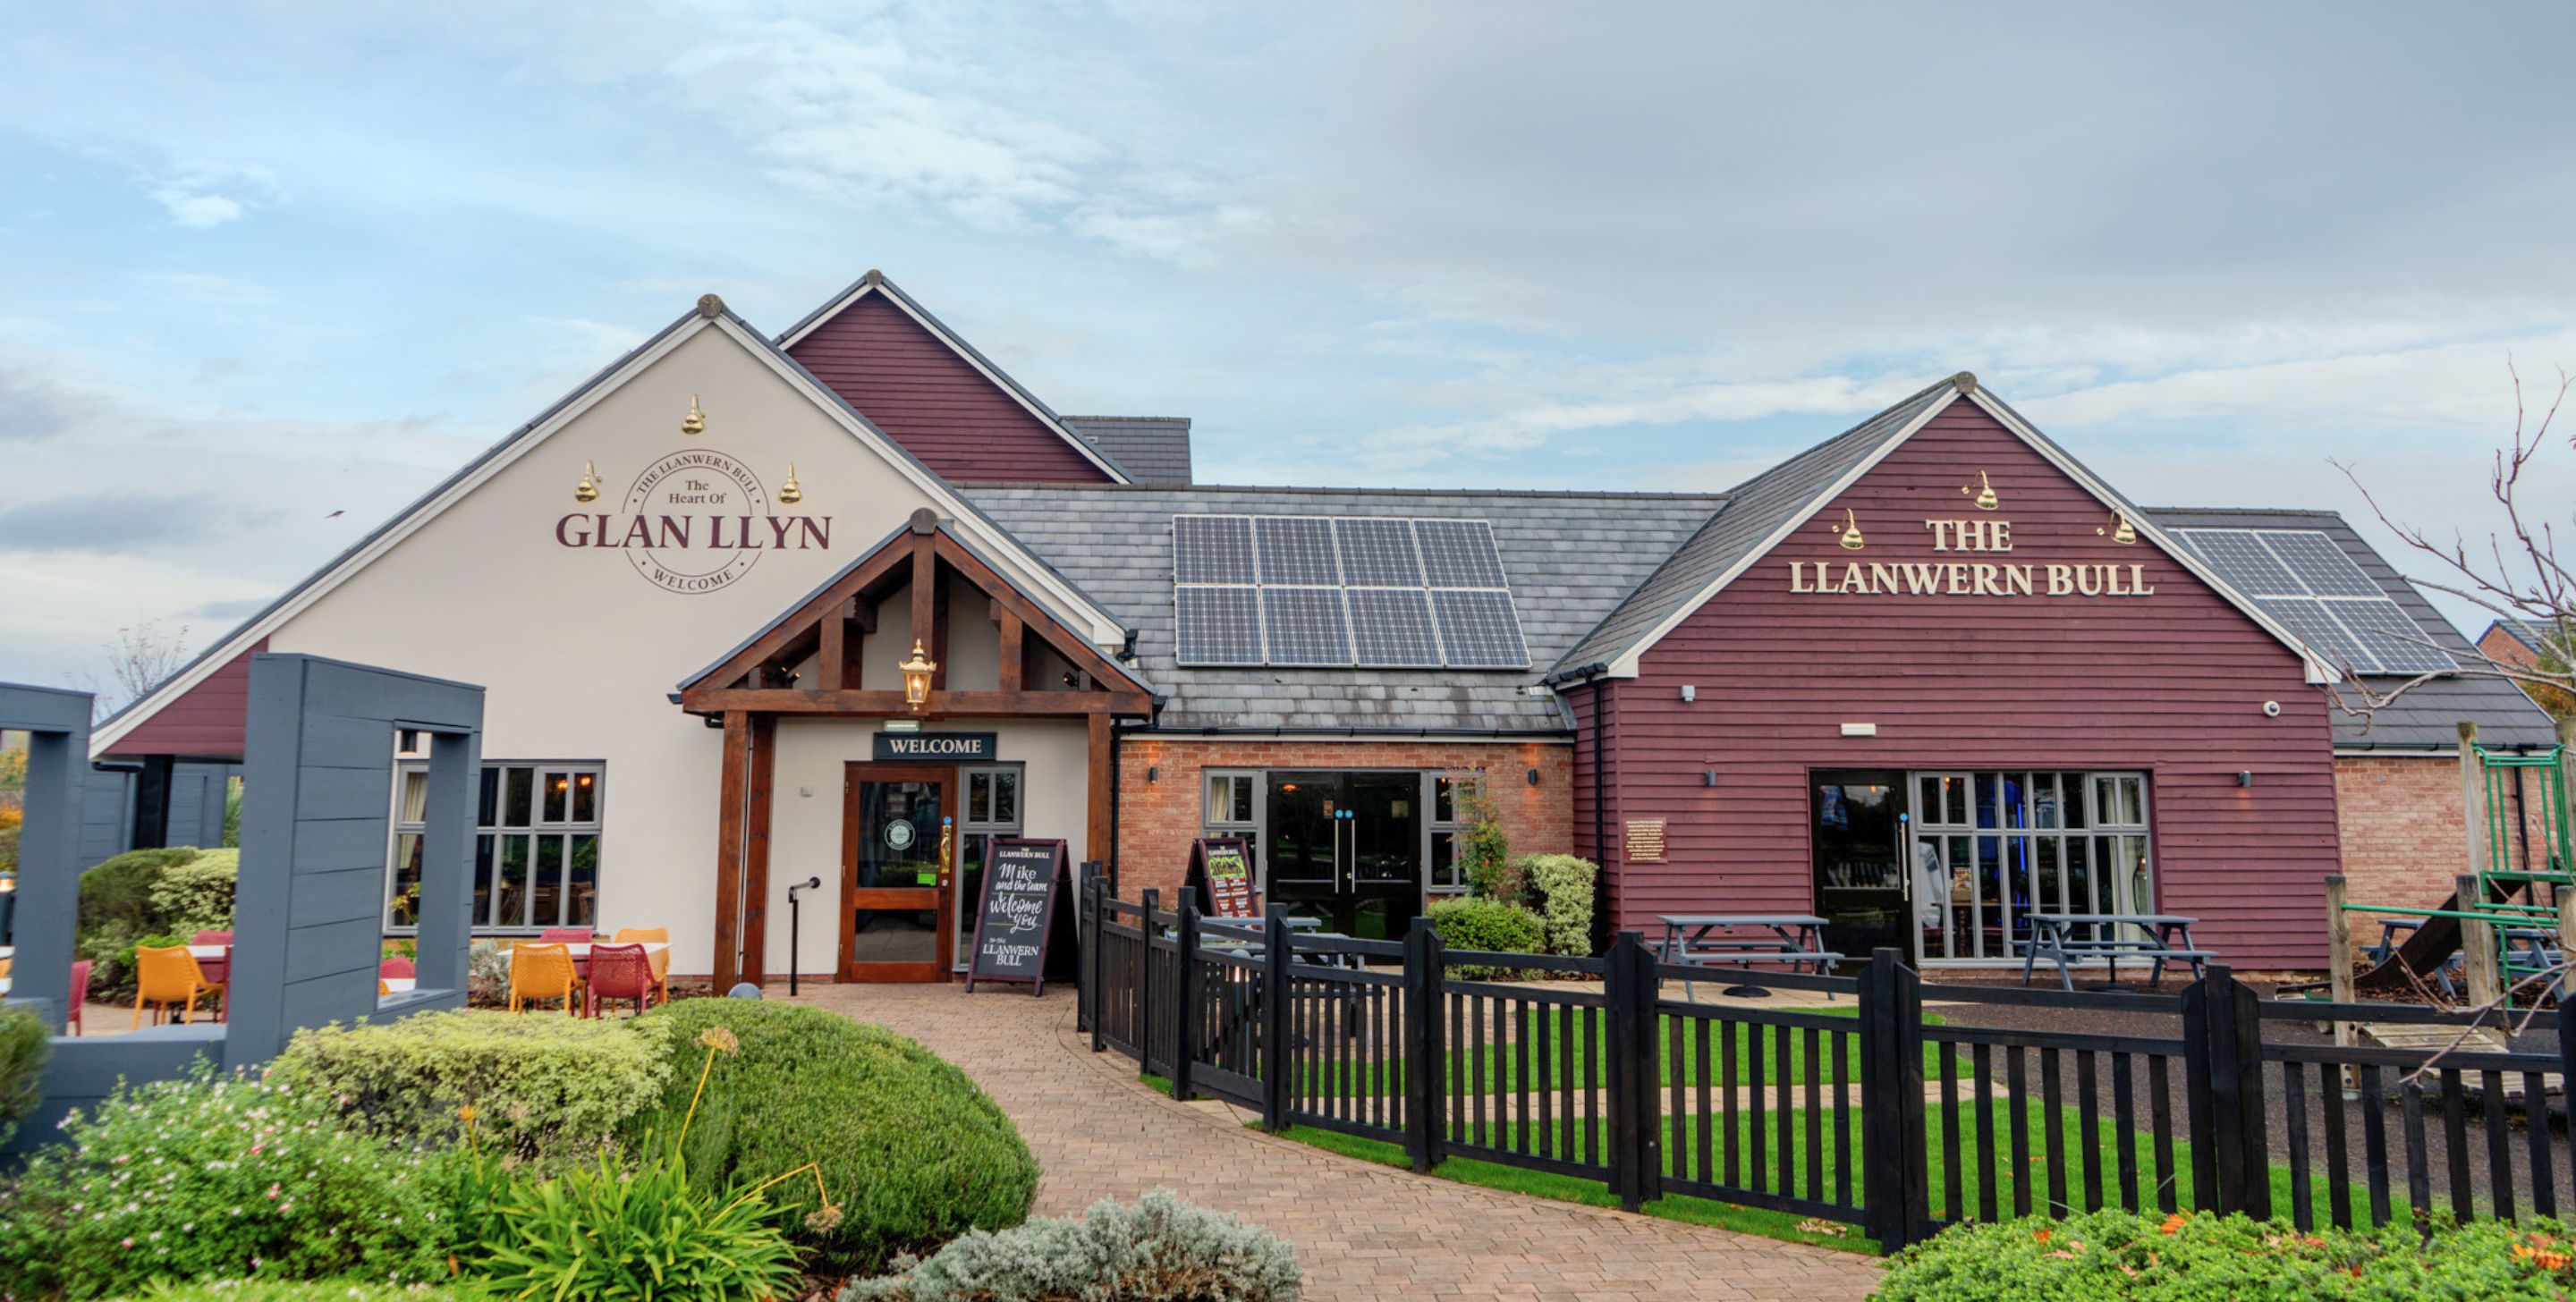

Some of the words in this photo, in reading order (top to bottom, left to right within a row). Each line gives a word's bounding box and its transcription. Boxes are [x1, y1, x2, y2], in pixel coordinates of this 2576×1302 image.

[636, 470, 659, 494] THE
[659, 454, 733, 475] LLANWERN
[732, 467, 758, 495] BULL
[685, 480, 709, 491] The
[669, 493, 706, 503] Heart
[709, 493, 727, 503] Of
[555, 513, 693, 549] GLAN
[708, 515, 833, 550] LLYN
[1925, 519, 2013, 553] THE
[653, 568, 733, 590] WELCOME
[1789, 562, 2035, 596] LLANWERN
[2045, 564, 2155, 596] BULL
[889, 739, 982, 754] WELCOME
[998, 863, 1037, 881] Mike
[996, 881, 1013, 891] and
[1013, 879, 1026, 891] the
[1027, 880, 1047, 892] team
[983, 943, 1039, 956] LLANWERN
[996, 954, 1021, 966] BULL
